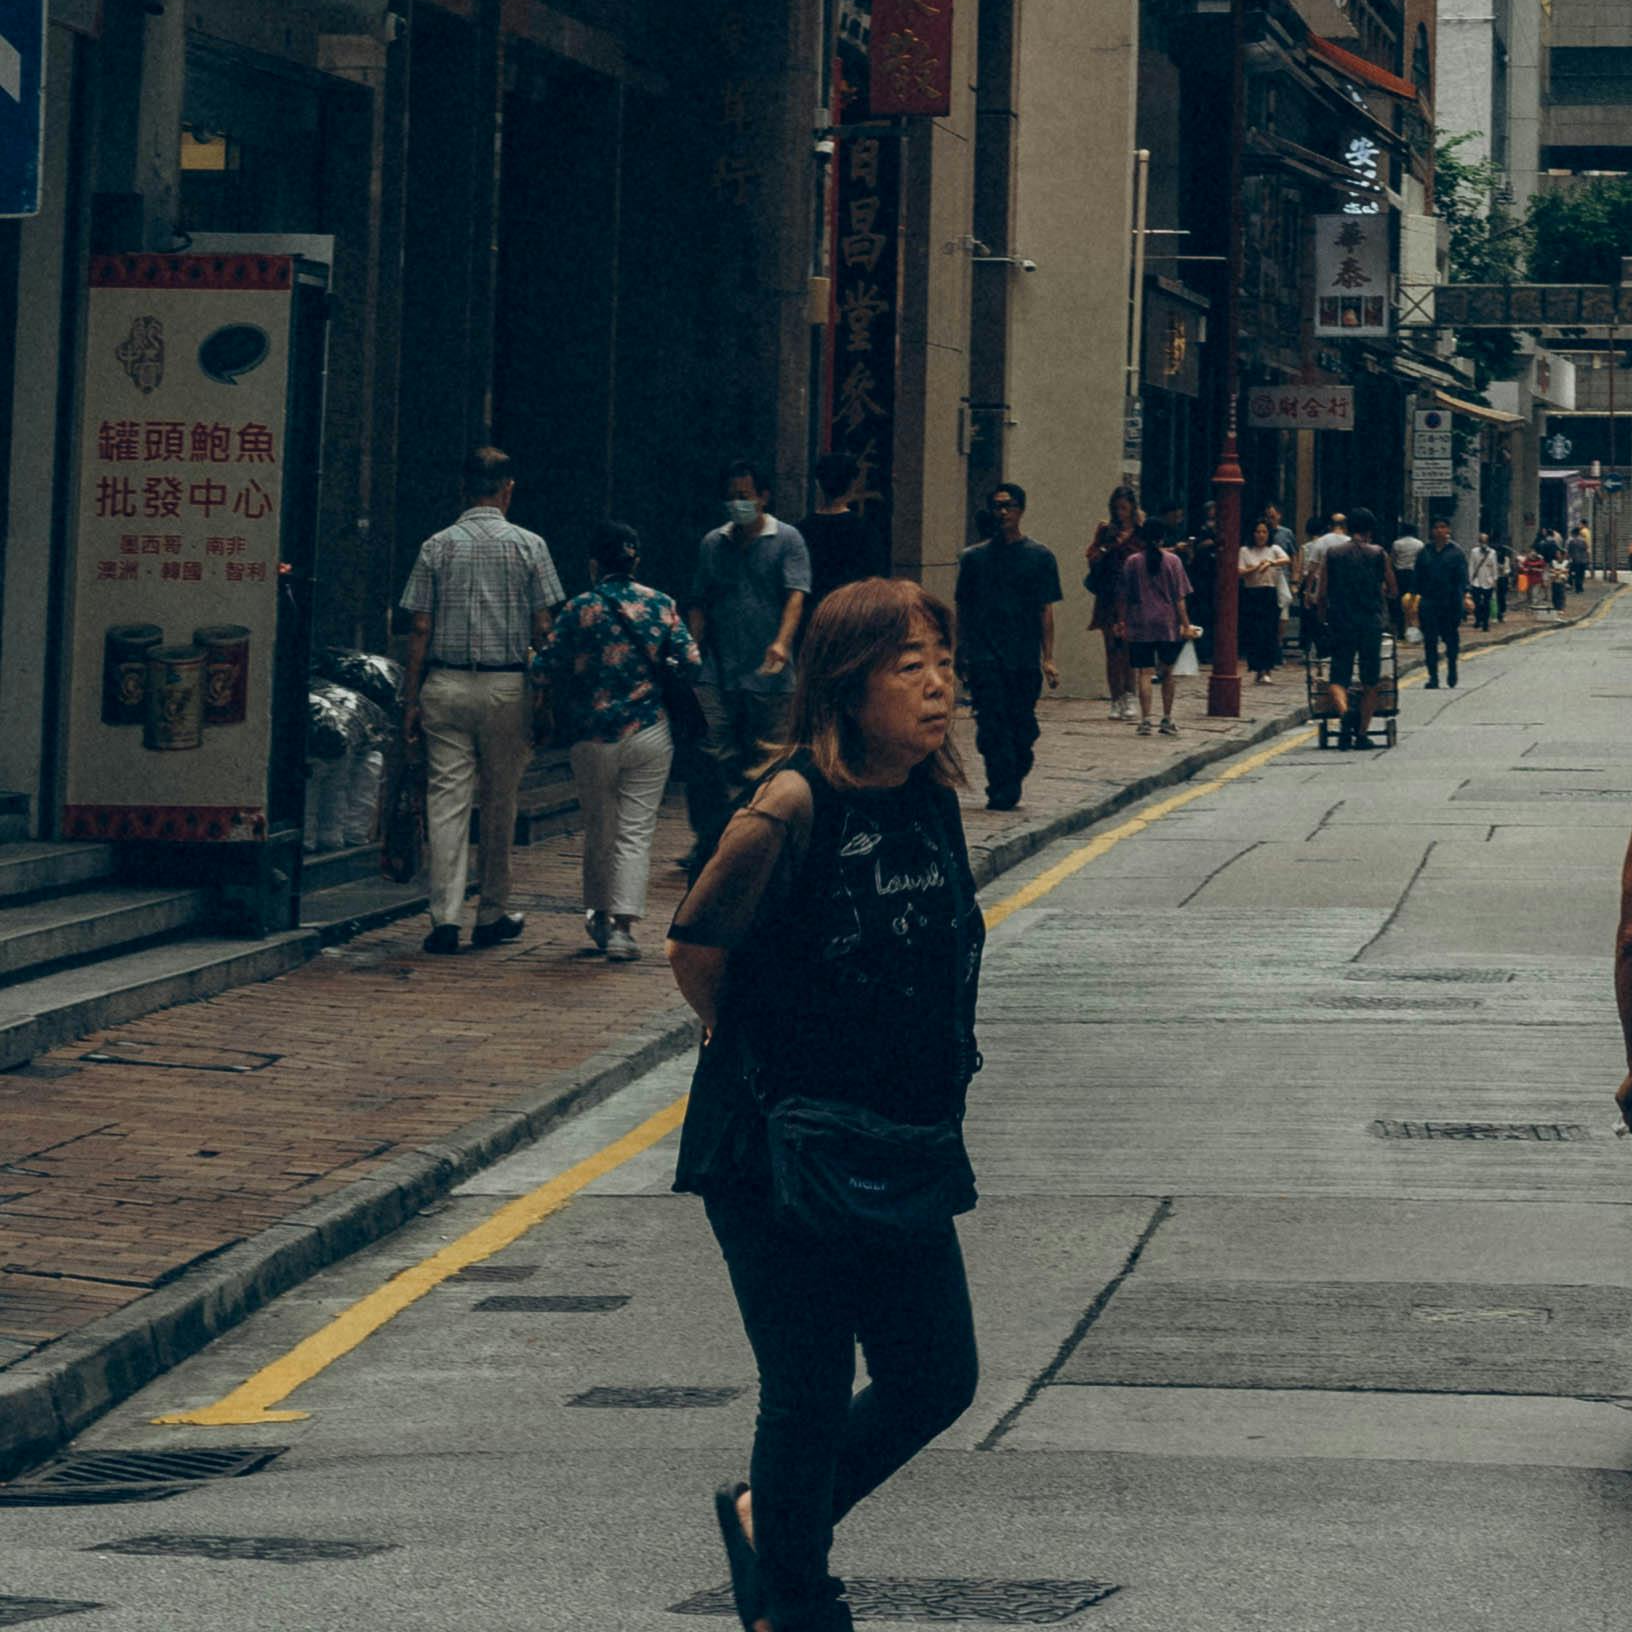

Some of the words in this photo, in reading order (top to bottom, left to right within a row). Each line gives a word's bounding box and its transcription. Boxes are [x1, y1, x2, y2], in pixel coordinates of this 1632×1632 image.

[98, 421, 275, 464] 罐頭鮑魚
[96, 477, 273, 520] 批發中心
